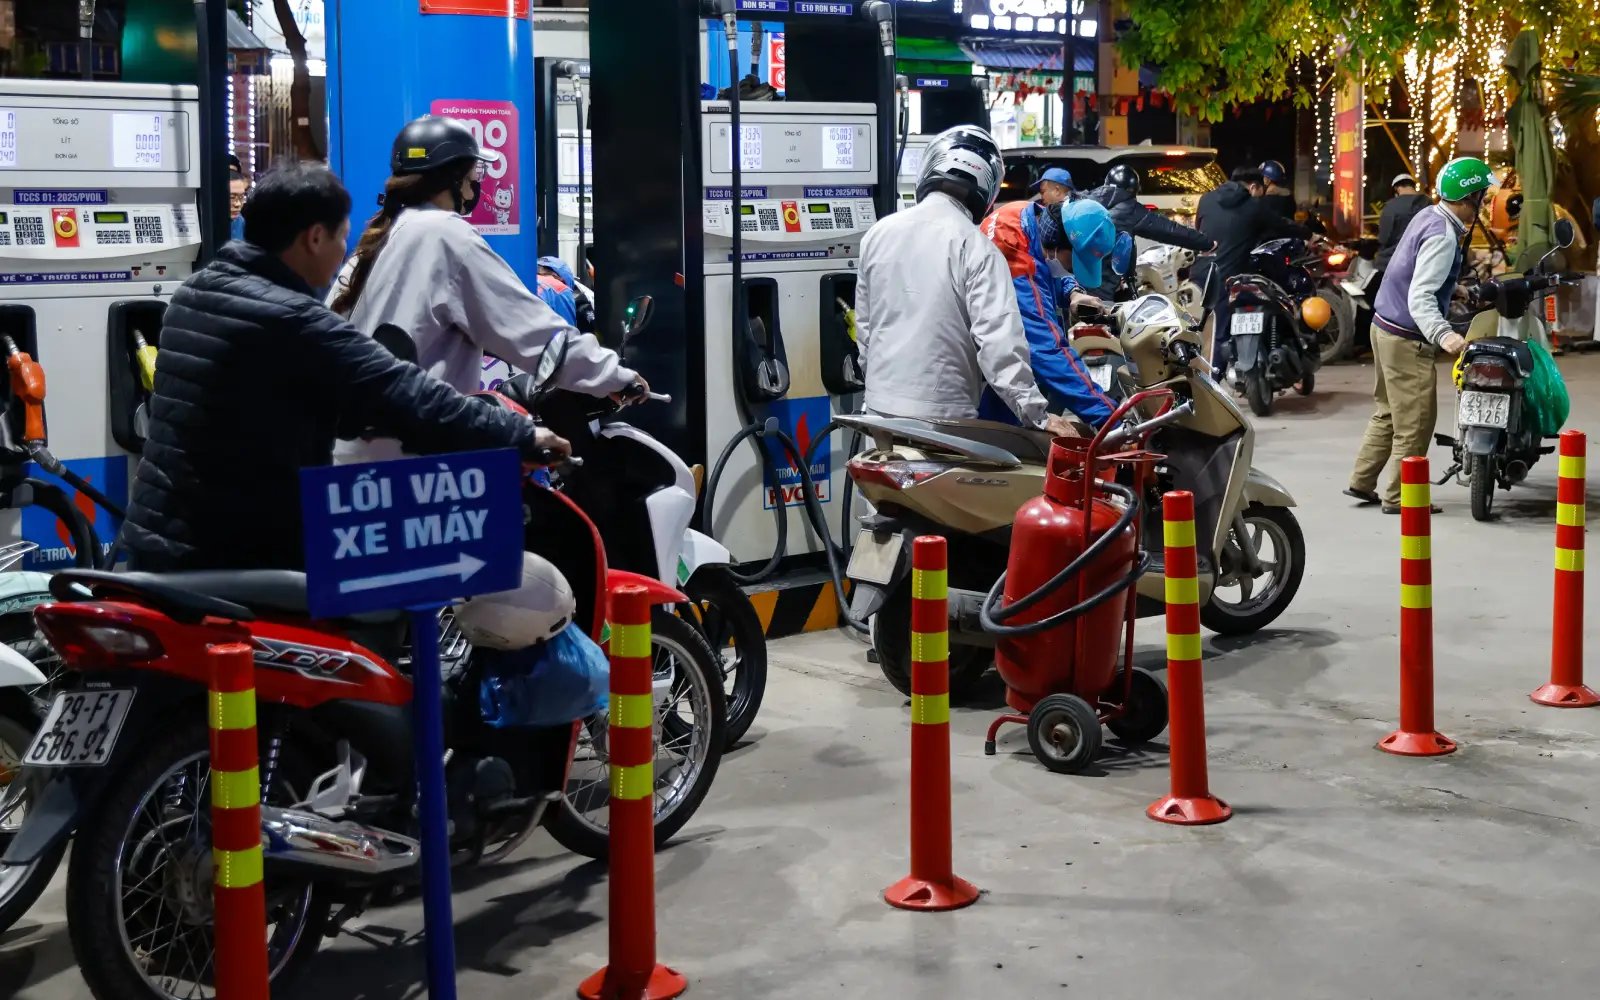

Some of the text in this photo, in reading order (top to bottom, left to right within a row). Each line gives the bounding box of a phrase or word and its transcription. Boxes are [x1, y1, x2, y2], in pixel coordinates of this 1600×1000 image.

[743, 1, 776, 10] RON 95-III
[801, 4, 847, 13] E10 RON 95-III
[1460, 174, 1482, 187] Grab
[19, 192, 103, 202] TCCS 01: 2025/PVOIL
[709, 190, 724, 198] TCCS
[807, 189, 824, 197] TCCS
[102, 272, 126, 280] BƠM
[327, 463, 487, 514] LỐI VÀO
[332, 505, 489, 560] XE MÁY
[55, 692, 119, 725] 29-F1
[32, 729, 110, 762] 686.94
